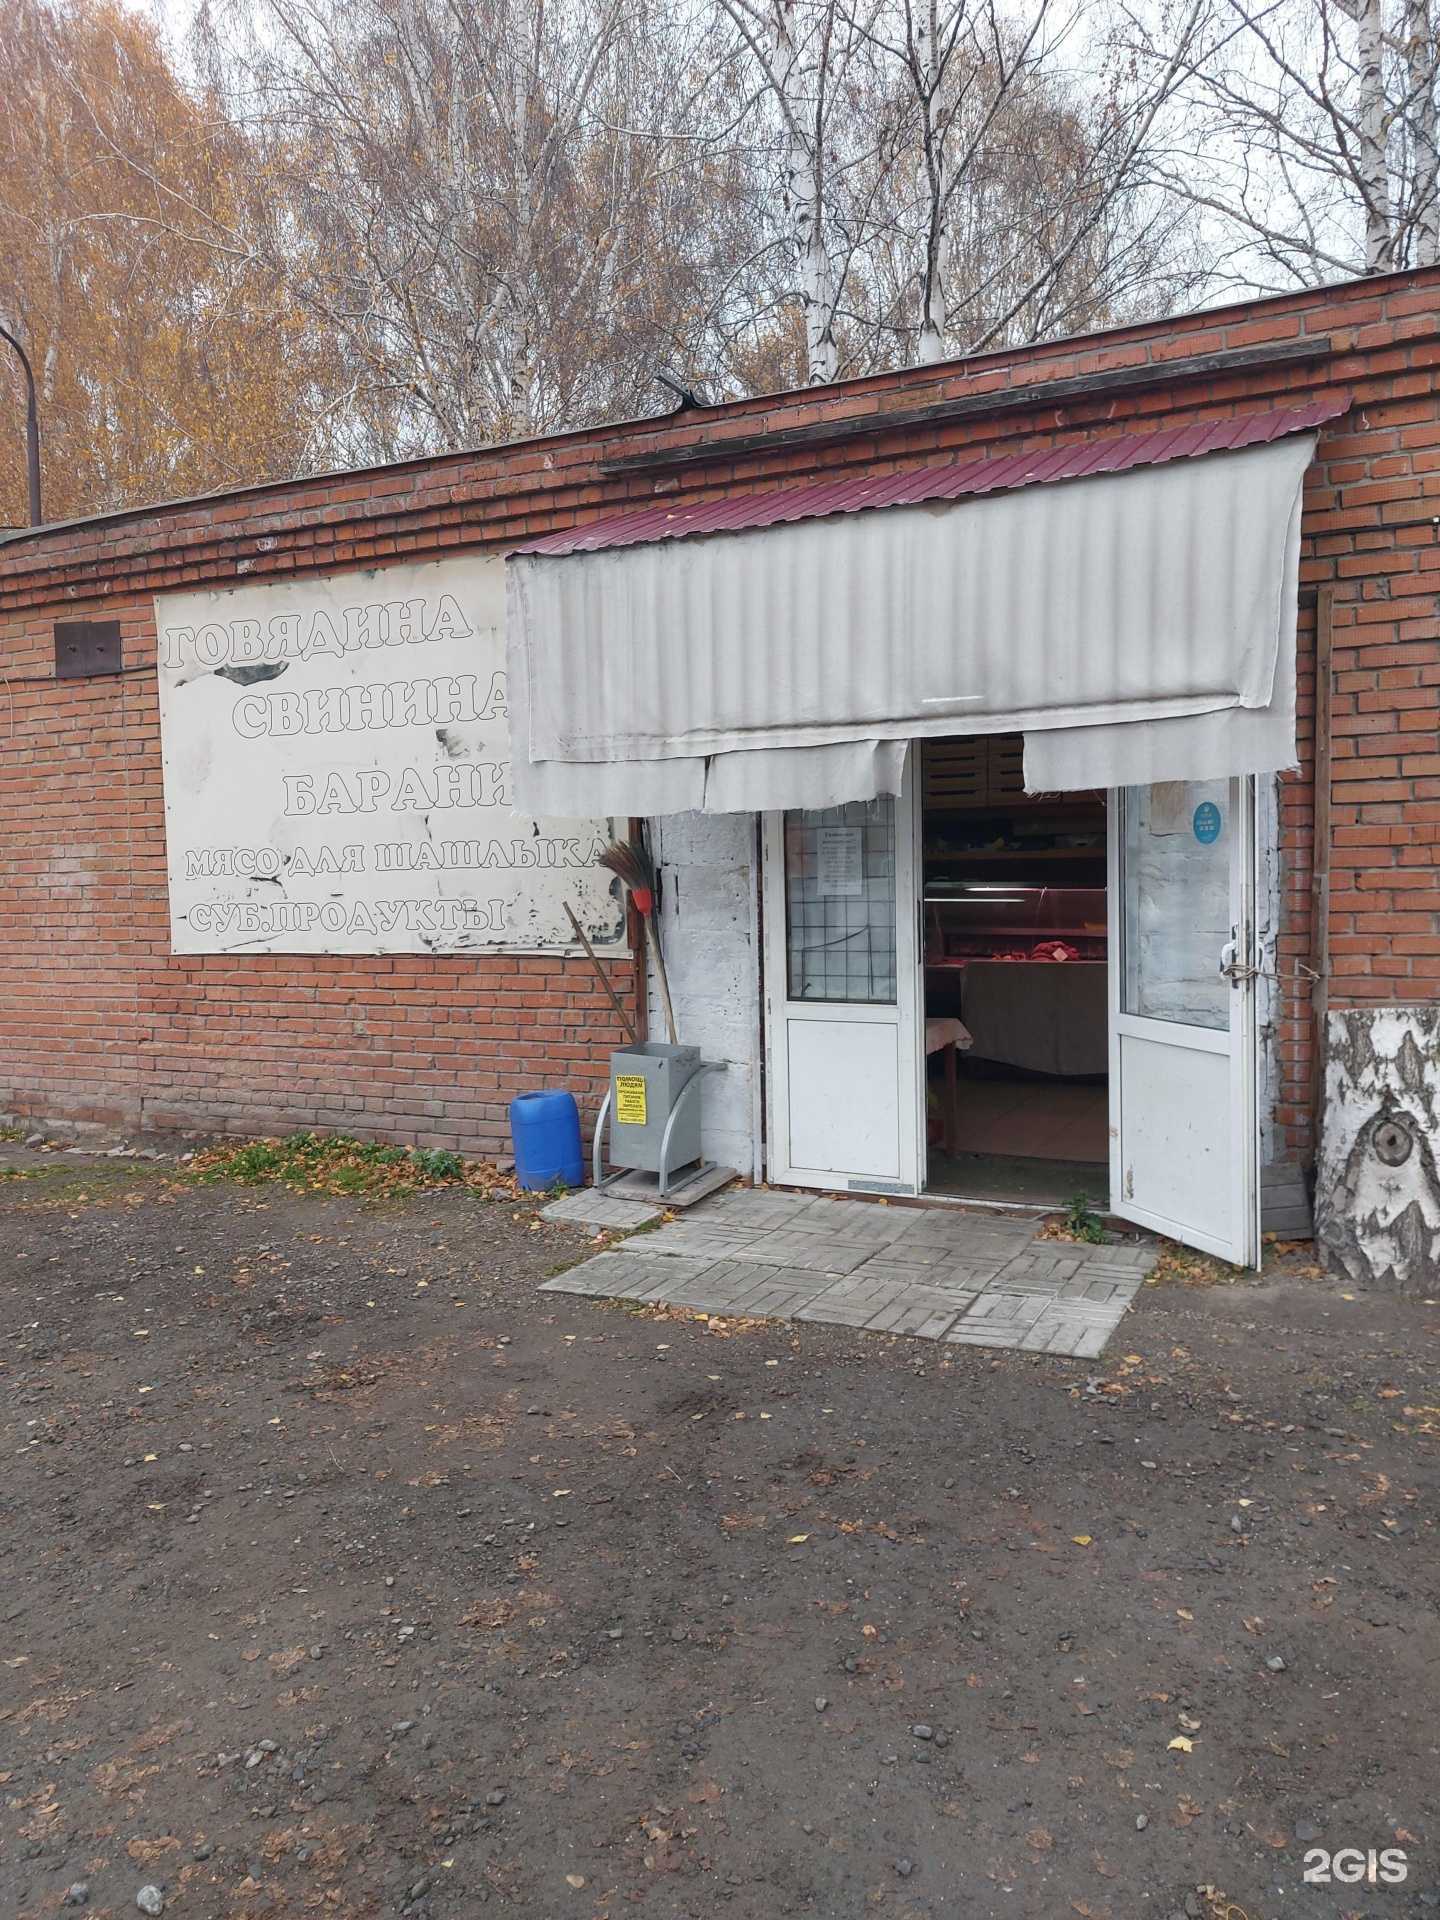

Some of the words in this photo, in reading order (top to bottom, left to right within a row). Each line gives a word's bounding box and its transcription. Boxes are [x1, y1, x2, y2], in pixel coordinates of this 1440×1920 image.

[163, 595, 474, 668] ГОВЯДИНА
[232, 671, 508, 739] СВИНИНА
[185, 848, 279, 877] МЯСО
[288, 844, 366, 877] ДЛЯ
[374, 838, 609, 871] ШАШЛЫКА
[188, 899, 505, 936] СУБ.ПРОДУКТЫ
